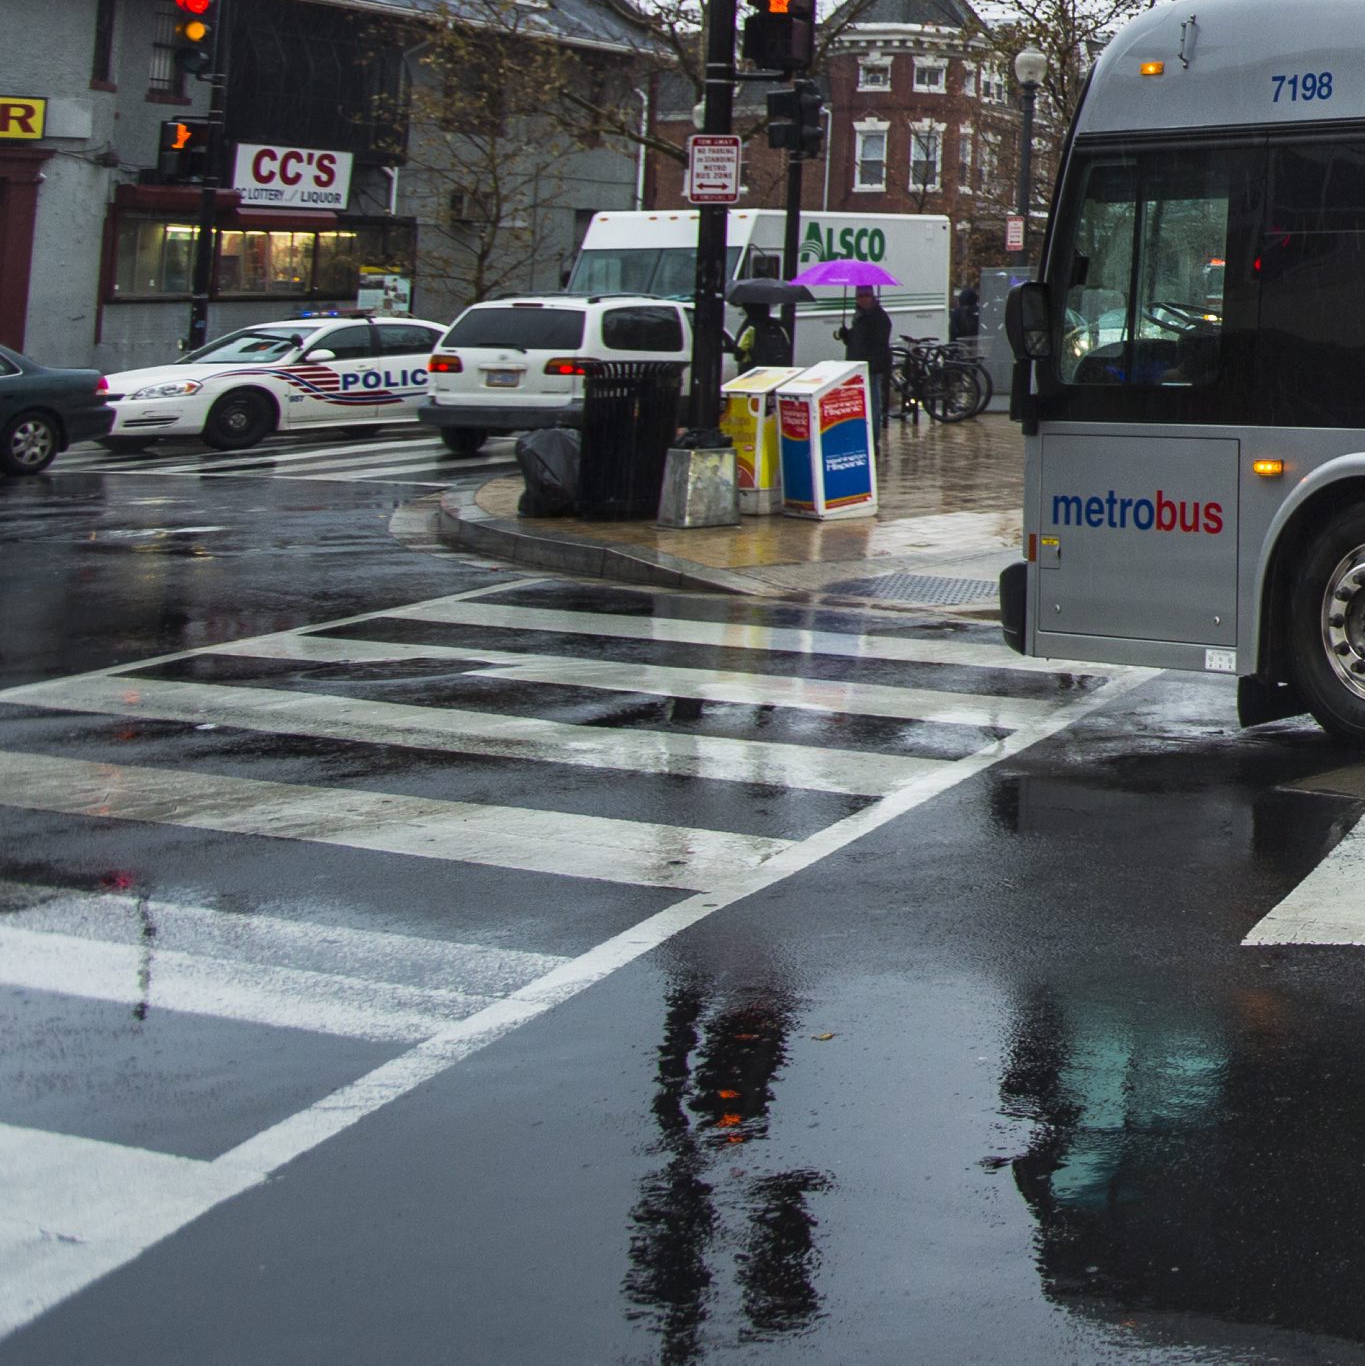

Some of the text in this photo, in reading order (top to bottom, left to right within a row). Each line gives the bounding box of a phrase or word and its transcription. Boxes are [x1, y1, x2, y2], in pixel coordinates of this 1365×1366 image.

[1271, 71, 1333, 103] 7198
[252, 149, 337, 188] CC'S
[301, 191, 342, 204] LIQUOR
[800, 222, 885, 264] ALSCO
[1052, 490, 1224, 534] metrobus
